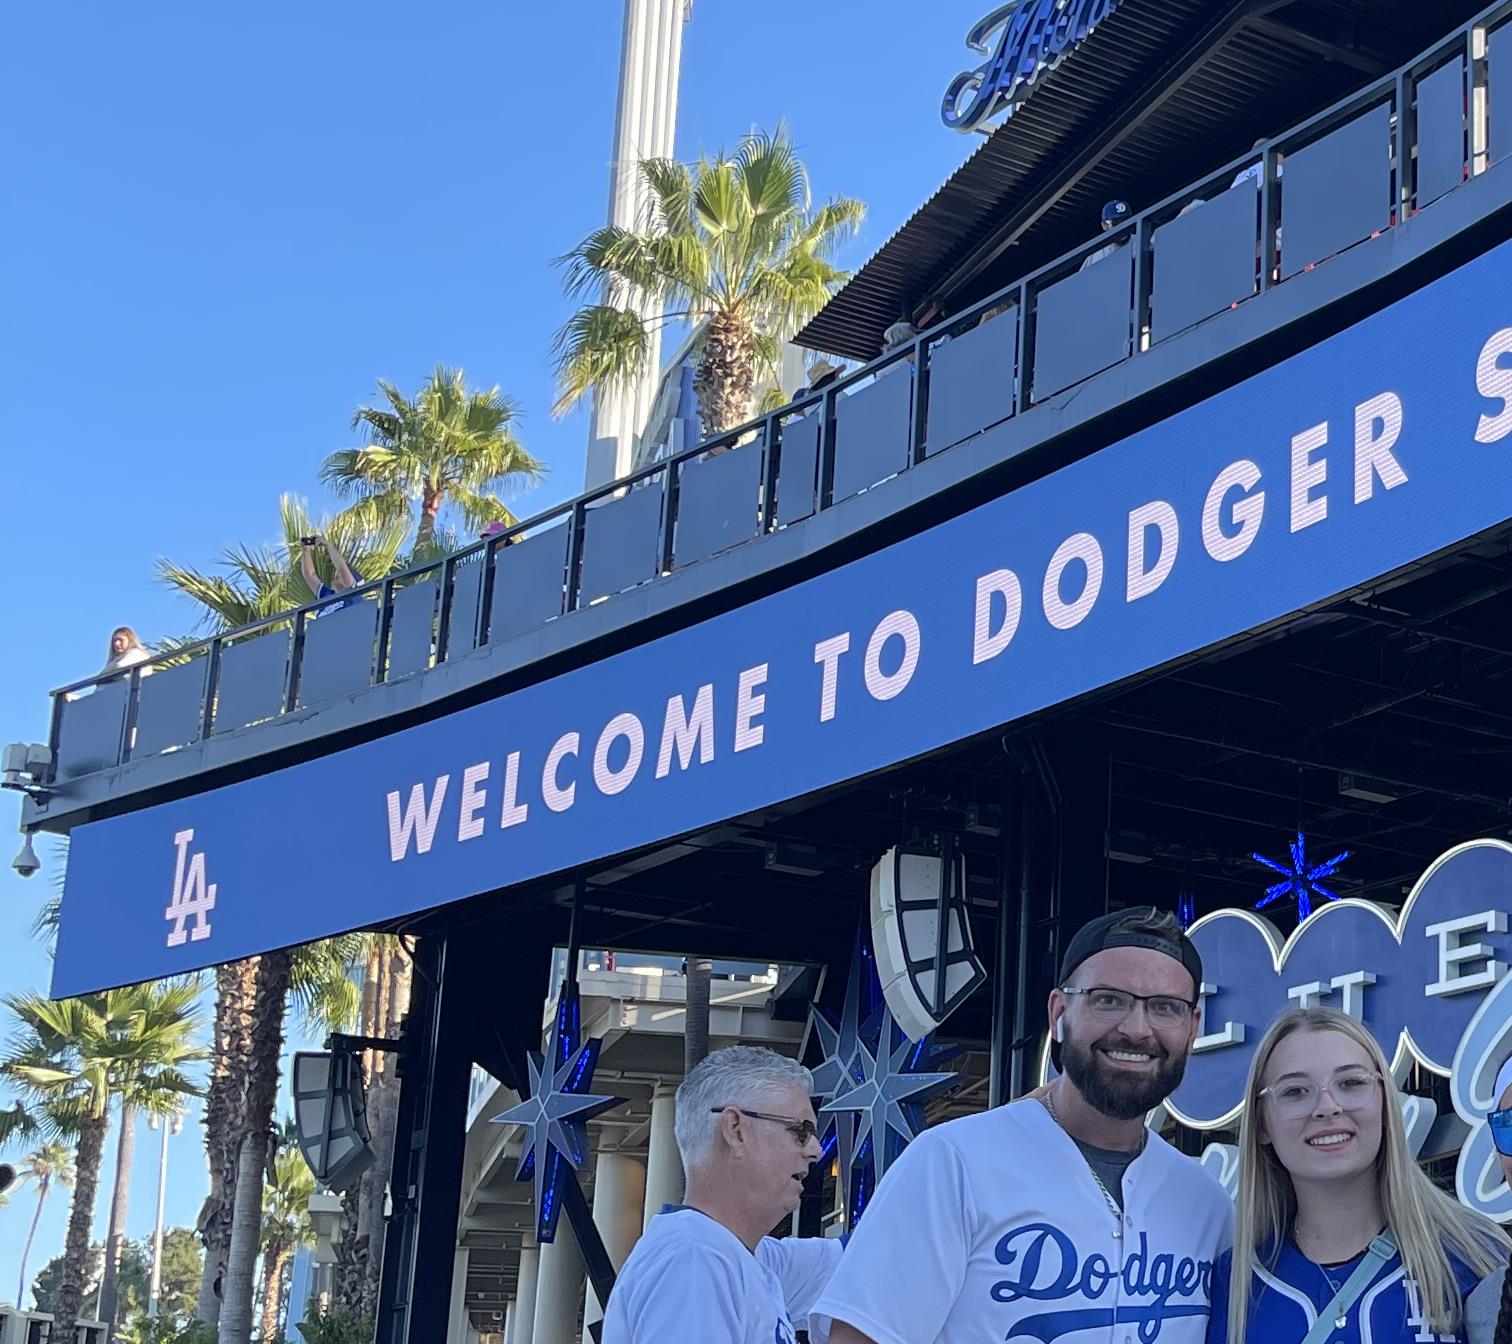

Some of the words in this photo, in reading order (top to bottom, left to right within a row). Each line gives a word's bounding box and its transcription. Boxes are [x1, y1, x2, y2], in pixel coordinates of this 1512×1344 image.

[386, 663, 769, 862] WELCOME
[814, 610, 922, 723] TO
[972, 391, 1409, 666] DODGER
[164, 827, 218, 948] LA
